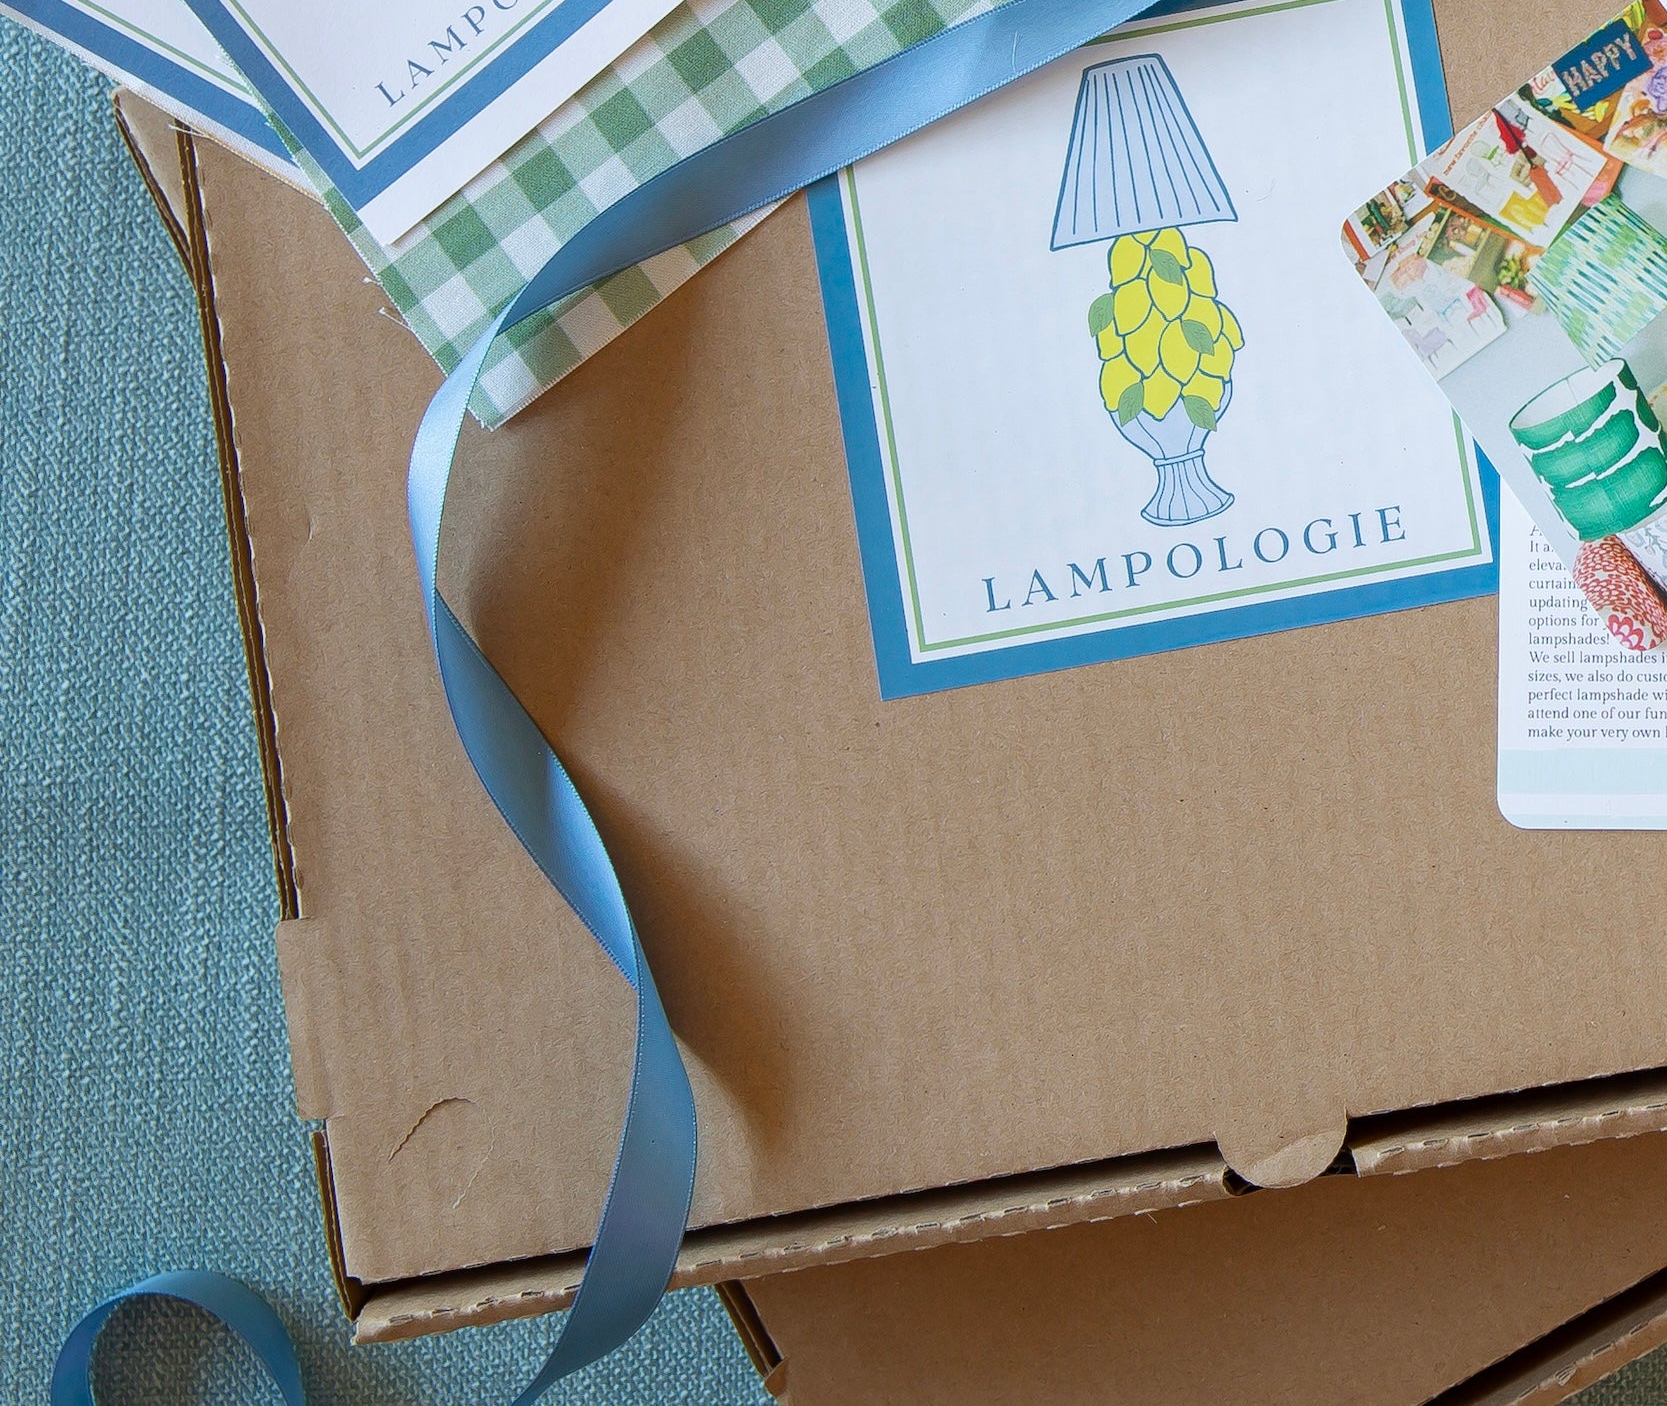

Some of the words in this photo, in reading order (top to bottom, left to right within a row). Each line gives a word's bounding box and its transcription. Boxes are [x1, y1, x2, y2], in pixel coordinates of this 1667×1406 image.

[1562, 32, 1637, 96] HAPPY
[1530, 540, 1538, 552] It
[981, 505, 1406, 612] LAMPOLOGIE
[1529, 558, 1566, 570] eleva
[1529, 595, 1588, 612] updating
[1529, 614, 1577, 631] options
[1582, 613, 1600, 626] for
[1529, 632, 1610, 650] lampshades!
[1529, 651, 1549, 663] We
[1553, 651, 1575, 663] sell
[1579, 651, 1657, 668] lampshades
[1528, 670, 1561, 684] sizes,
[1564, 673, 1583, 682] we
[1587, 670, 1613, 682] also
[1617, 670, 1634, 682] do
[1528, 688, 1573, 705] perfect
[1577, 688, 1648, 705] lampshade
[1528, 706, 1569, 719] attend
[1573, 710, 1597, 719] one
[1601, 707, 1616, 719] of
[1617, 711, 1642, 719] our
[1645, 707, 1667, 719] fun
[1528, 725, 1563, 738] make
[1567, 729, 1597, 743] your
[1600, 730, 1629, 743] very
[1632, 730, 1660, 738] own
